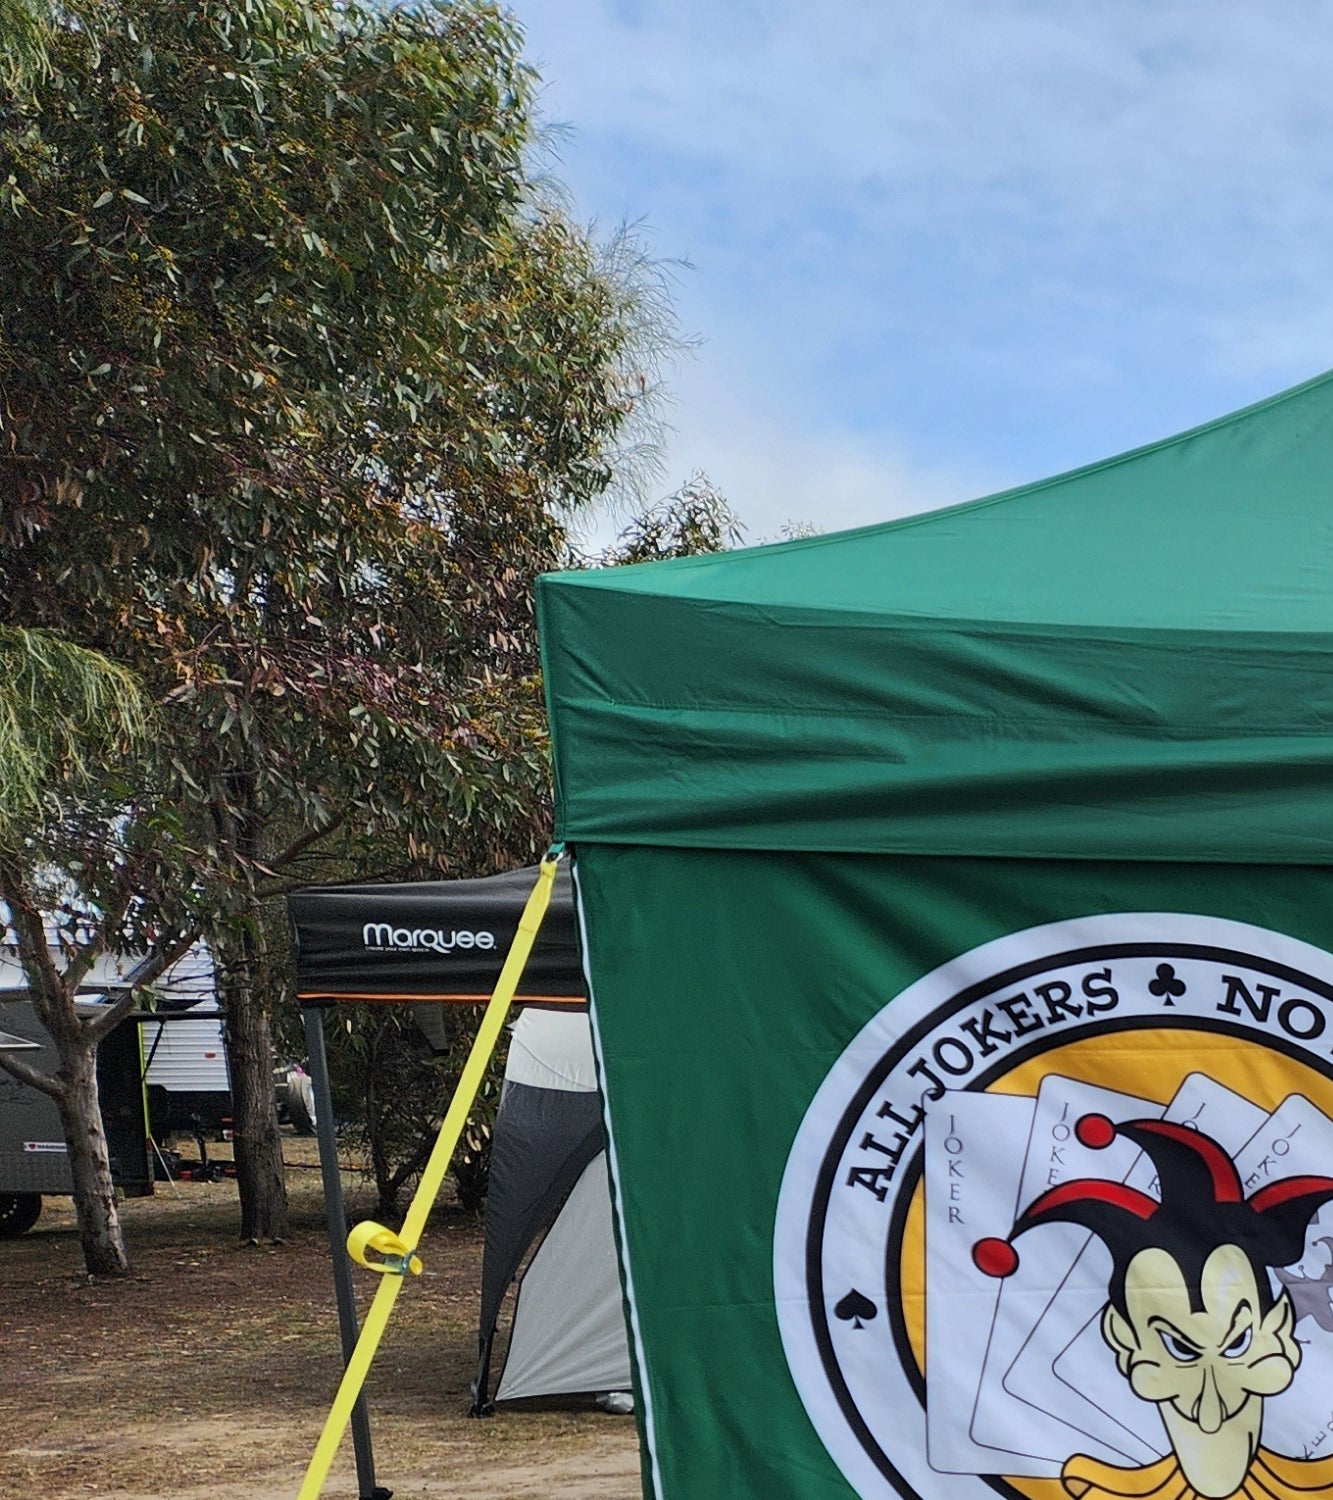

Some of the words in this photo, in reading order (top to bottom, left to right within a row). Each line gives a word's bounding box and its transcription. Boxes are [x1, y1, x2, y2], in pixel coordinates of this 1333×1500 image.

[846, 1100, 927, 1203] ALL
[906, 967, 1119, 1102] JOKERS
[1216, 974, 1326, 1040] NO
[943, 1114, 965, 1224] JOKER
